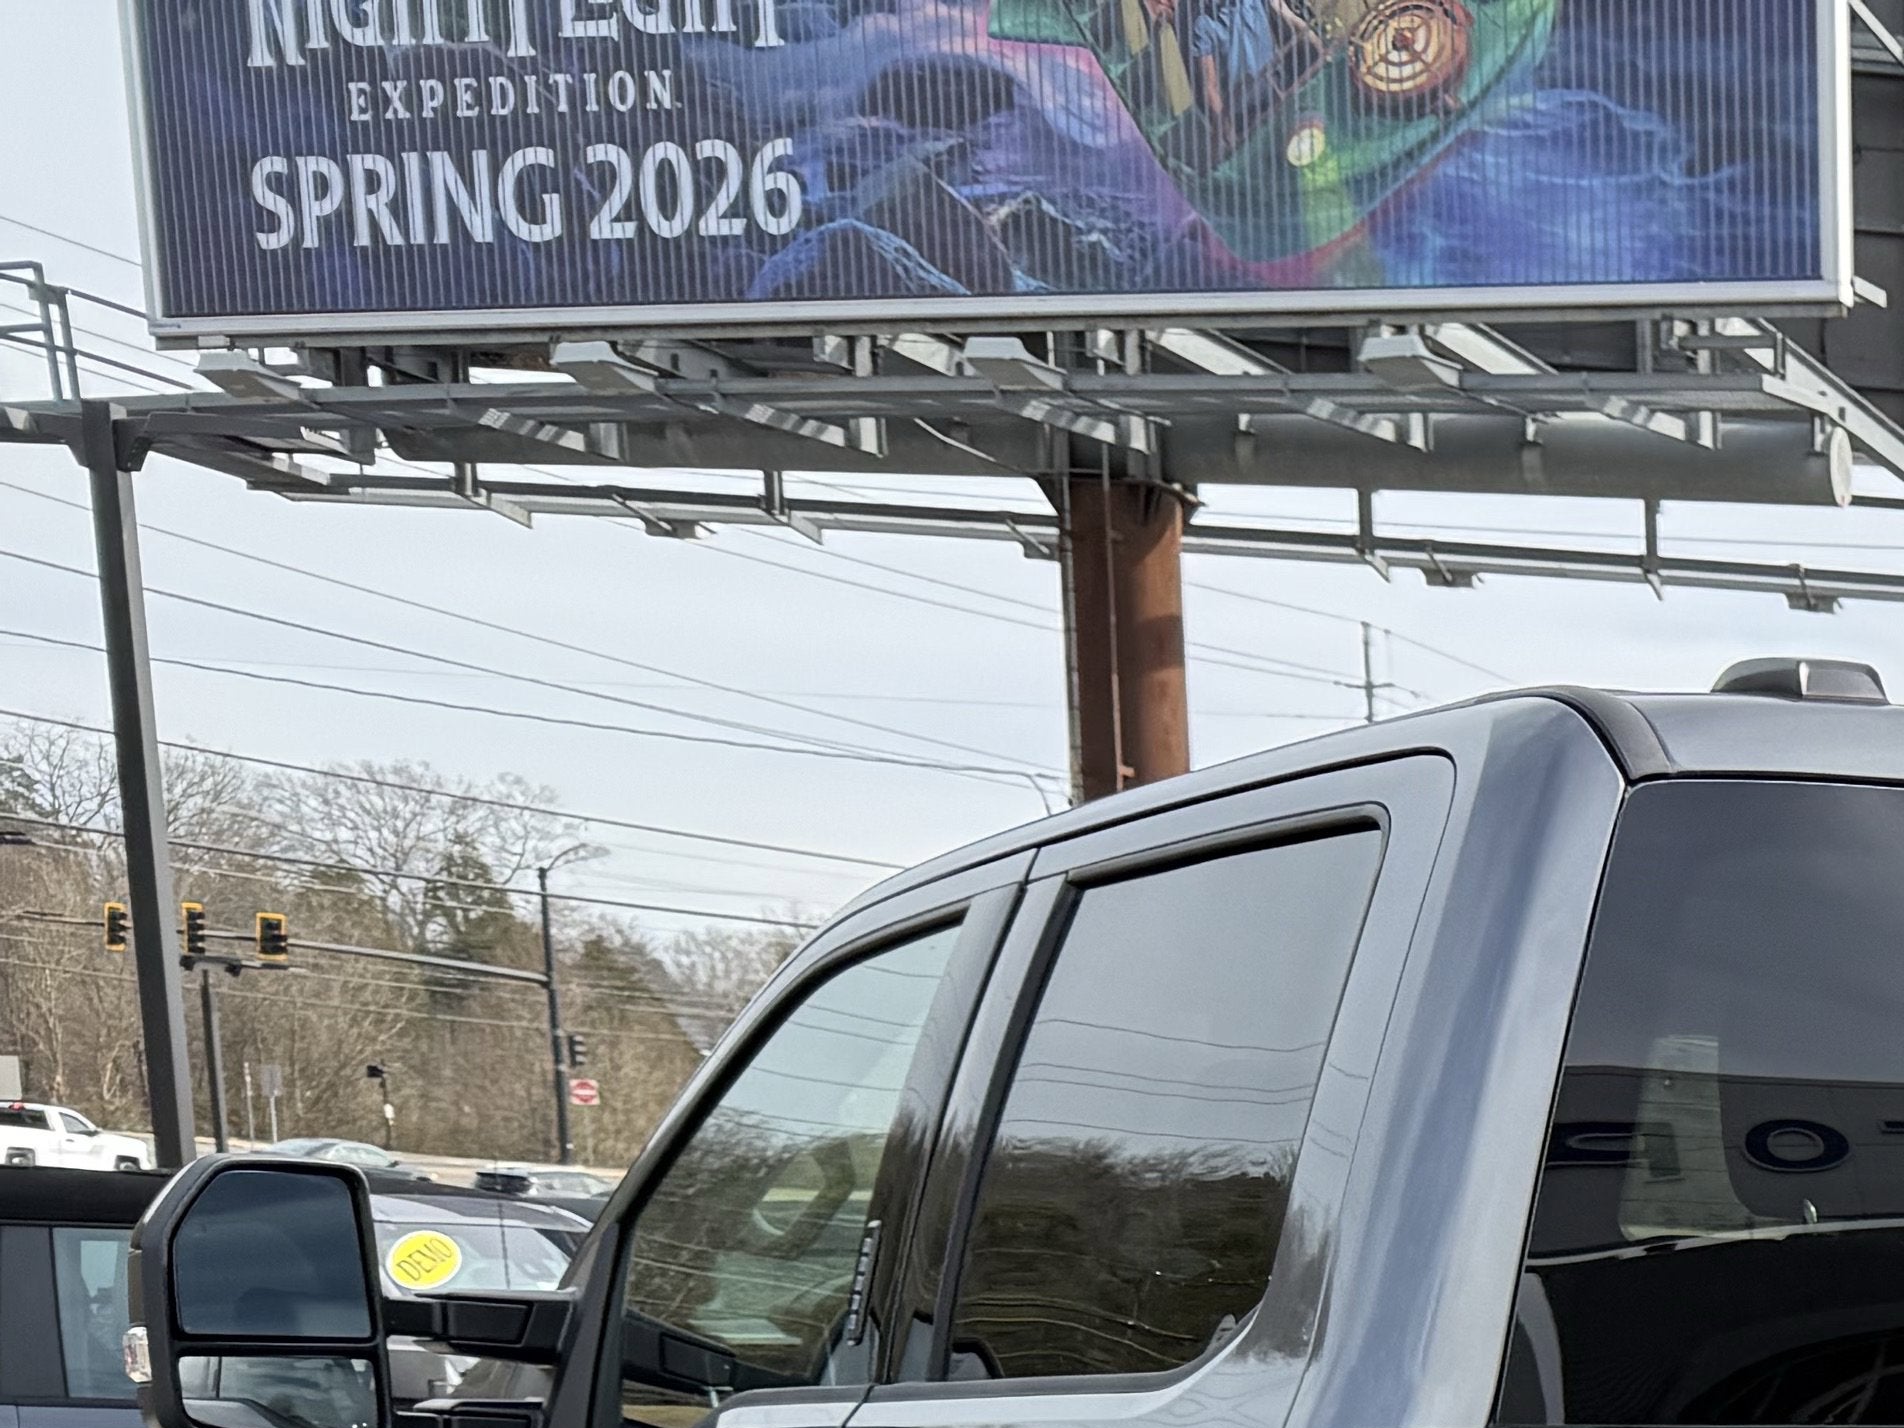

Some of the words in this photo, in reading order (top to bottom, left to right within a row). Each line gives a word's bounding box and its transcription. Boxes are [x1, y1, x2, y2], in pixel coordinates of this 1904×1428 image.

[348, 68, 674, 121] EXPEDITION
[253, 145, 565, 252] SPRING
[587, 137, 801, 242] 2026
[396, 1238, 452, 1281] DEMO
